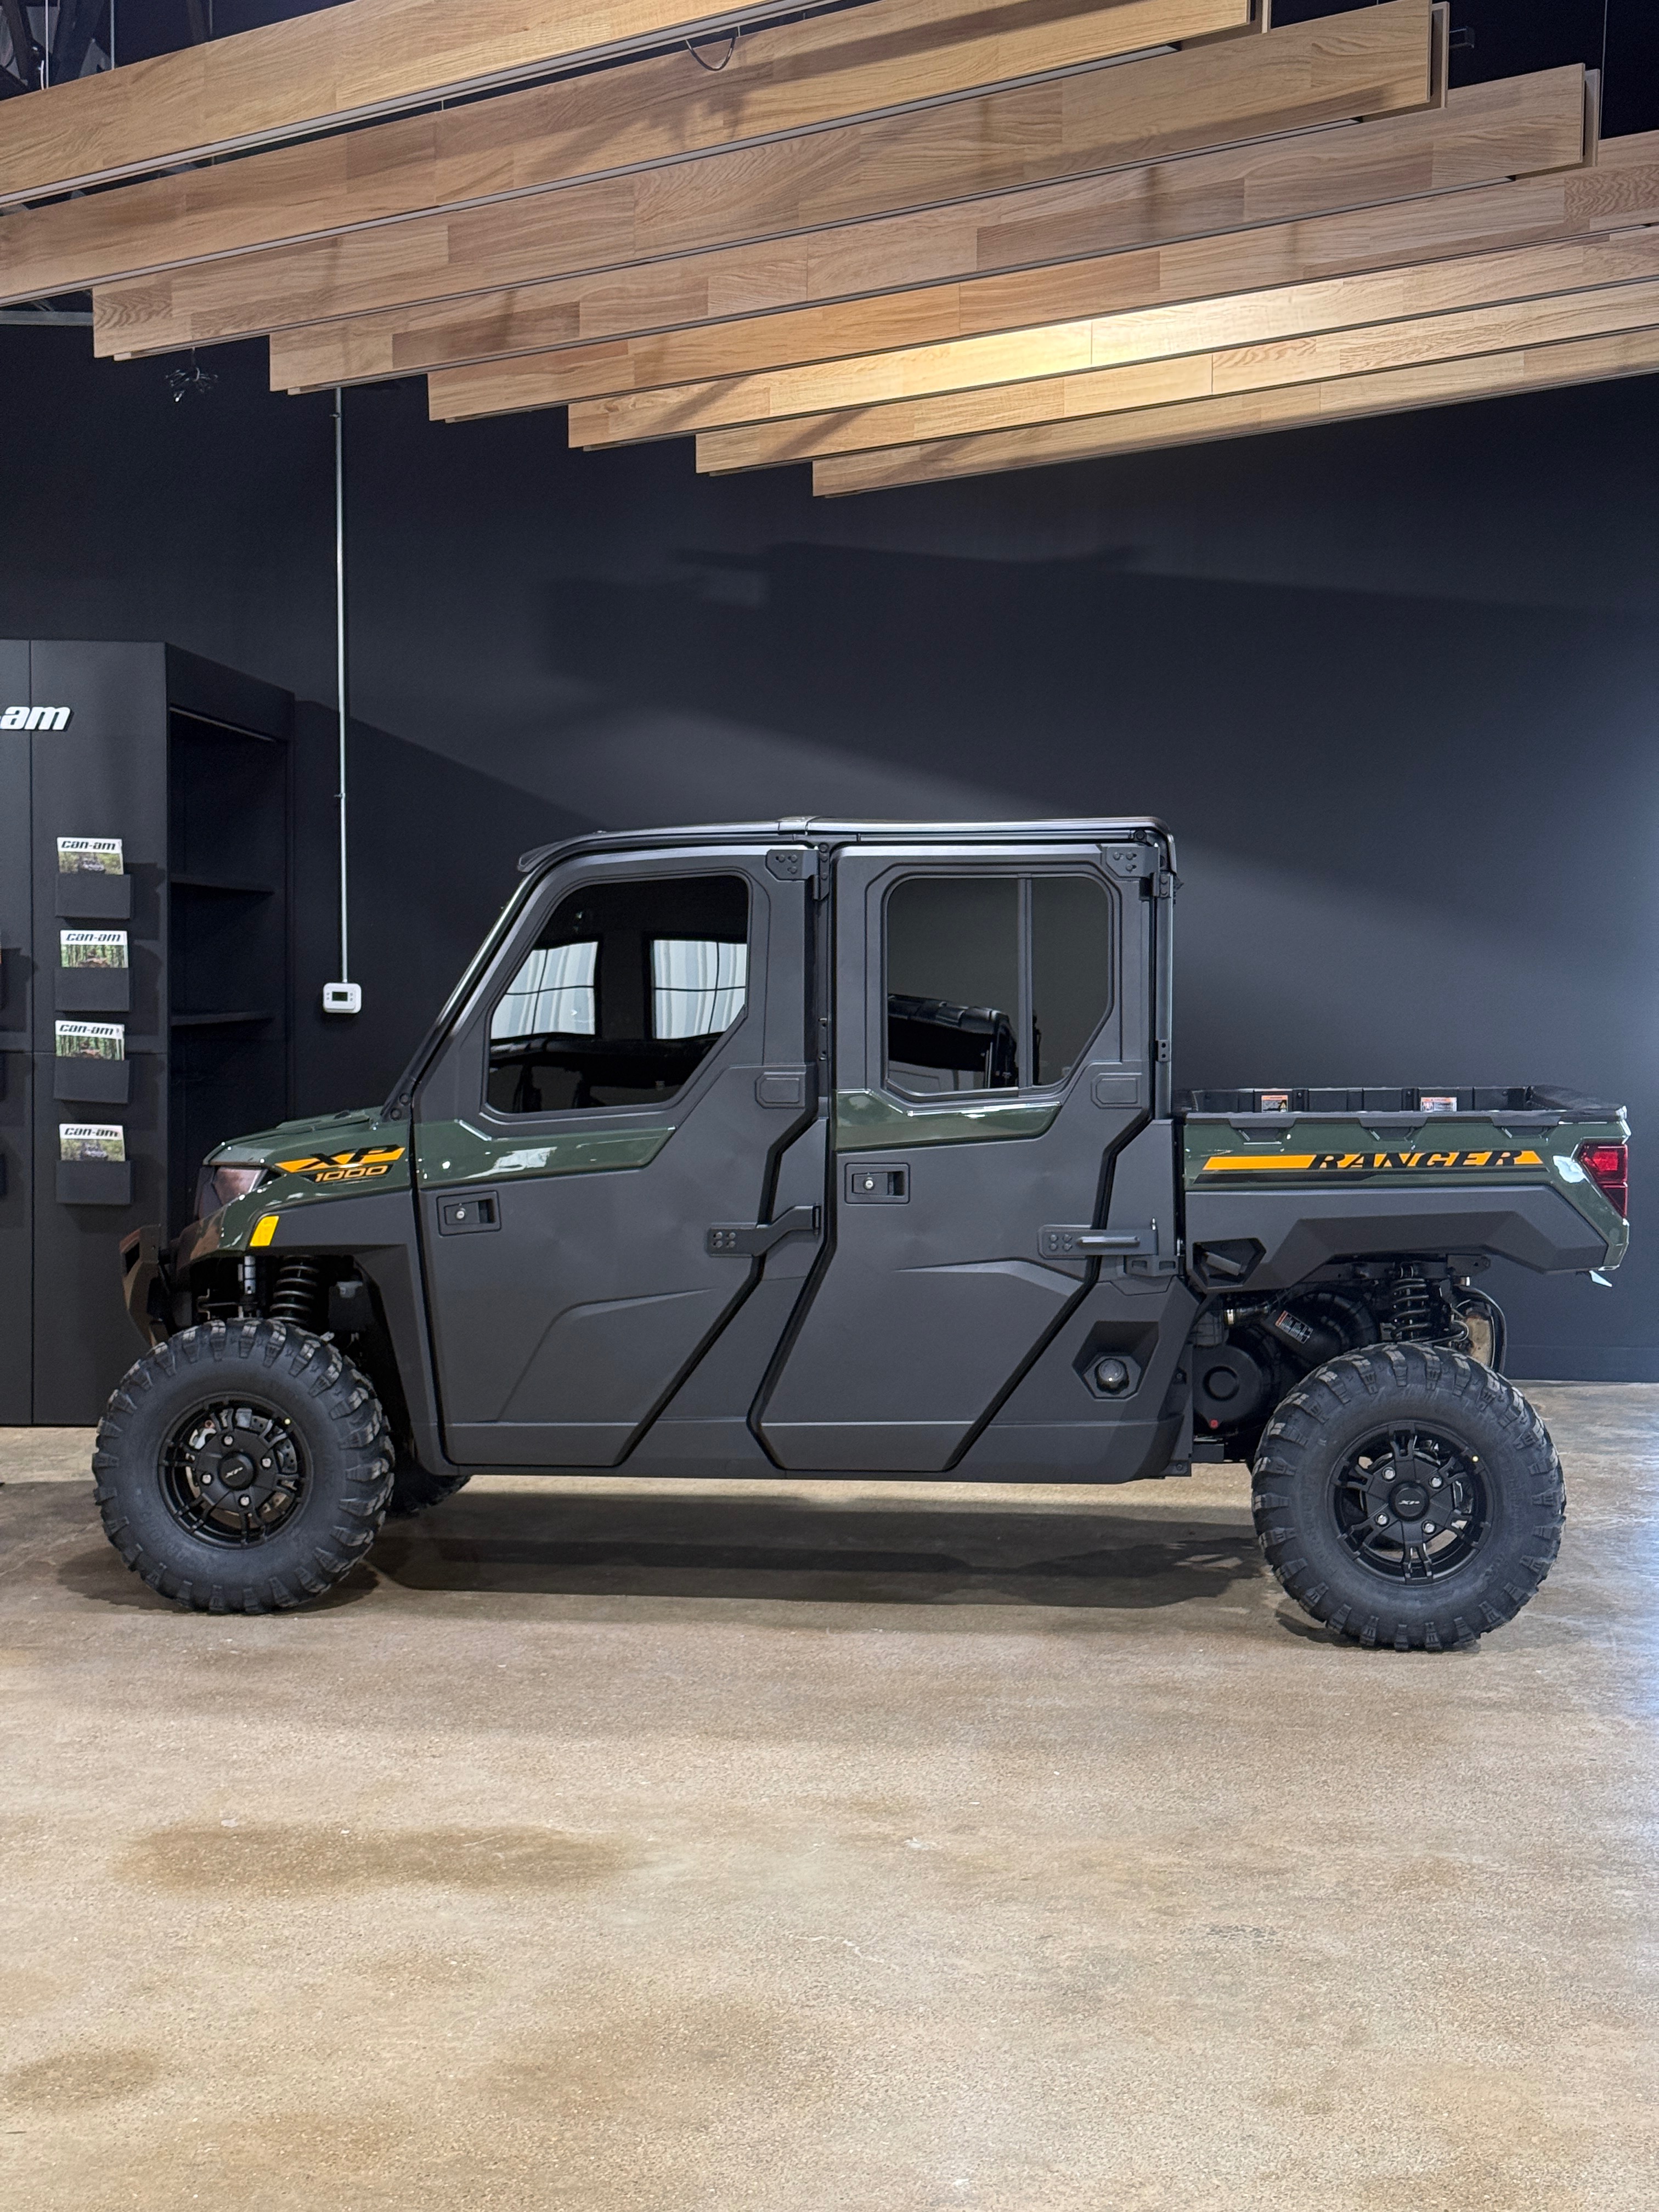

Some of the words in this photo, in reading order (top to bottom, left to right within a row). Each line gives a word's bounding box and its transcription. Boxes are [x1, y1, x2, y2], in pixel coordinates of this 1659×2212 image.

[61, 840, 116, 850] can-am
[66, 933, 121, 942] can-am
[59, 1024, 114, 1036] can-am
[64, 1127, 119, 1137] can-am
[296, 1144, 400, 1170] XP
[1308, 1150, 1522, 1169] RANGER
[315, 1165, 388, 1182] 1000
